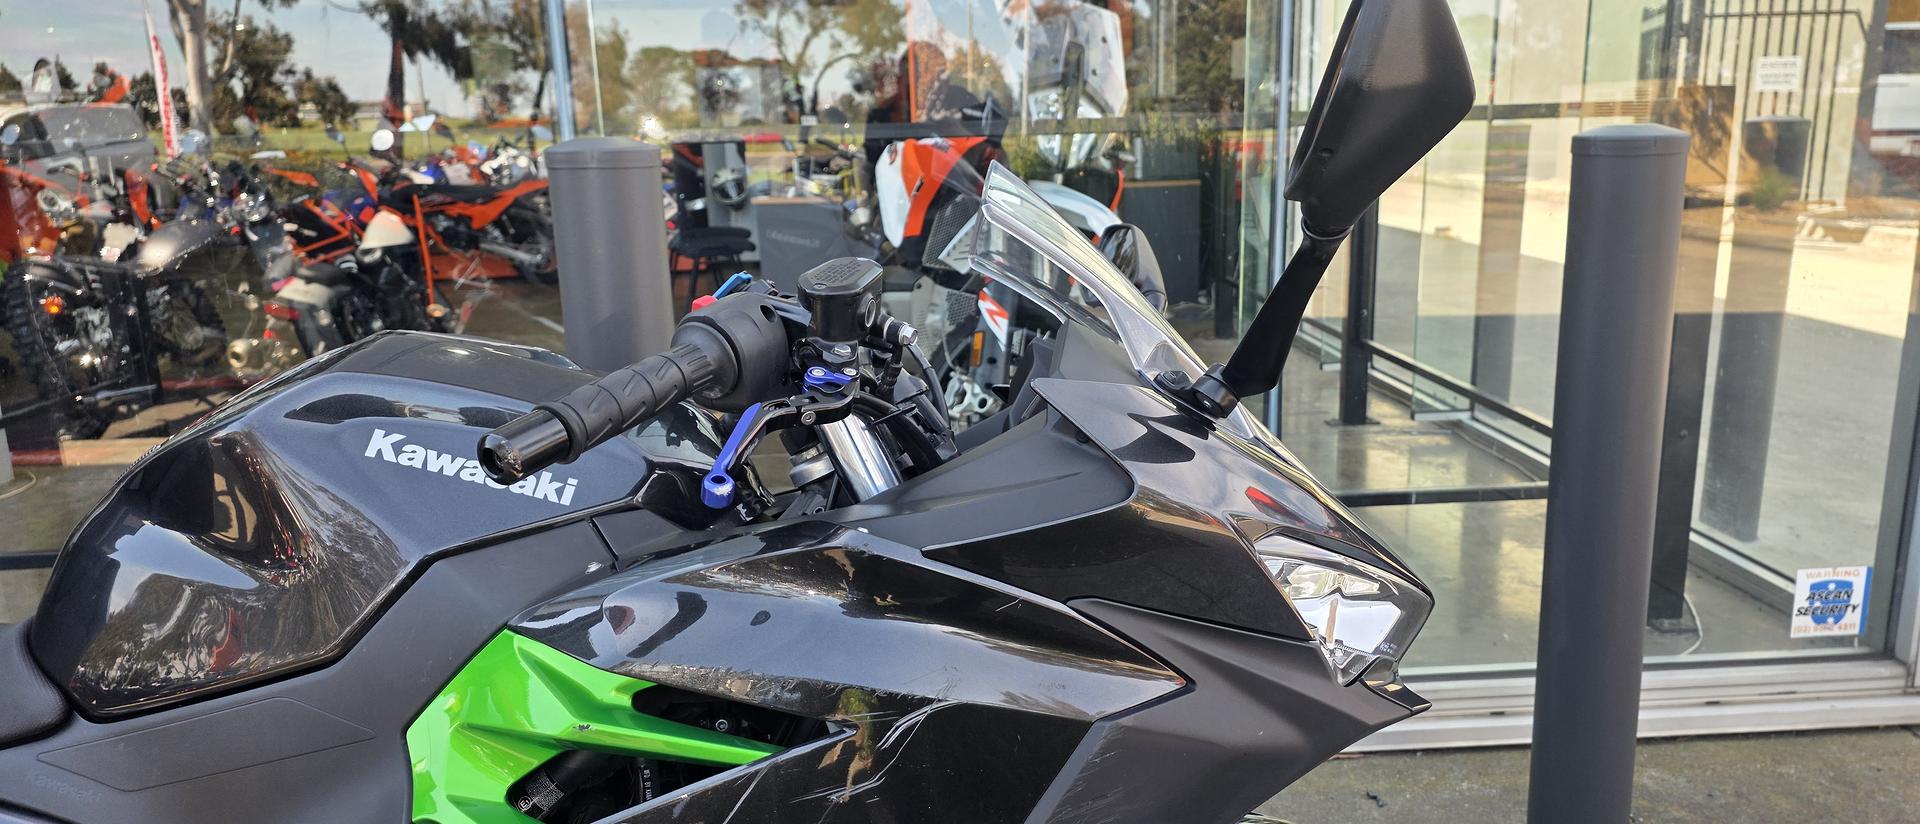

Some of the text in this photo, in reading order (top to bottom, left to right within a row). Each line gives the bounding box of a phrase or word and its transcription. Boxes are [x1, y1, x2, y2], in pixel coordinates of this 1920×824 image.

[364, 428, 578, 506] Kawaaki
[1807, 568, 1860, 578] WARNING
[1805, 589, 1854, 601] ASCAN
[1795, 604, 1860, 617] SECURITY
